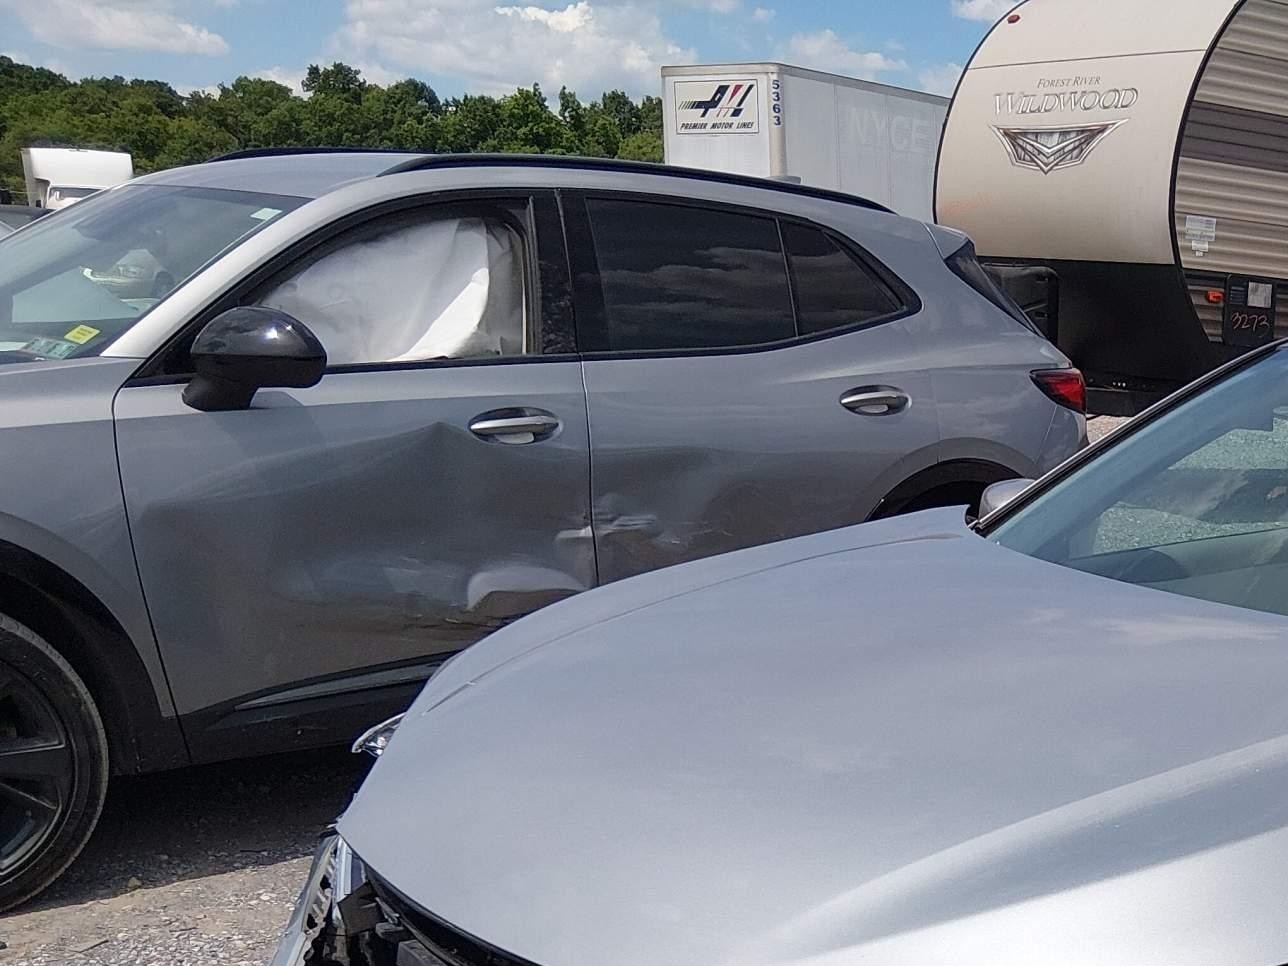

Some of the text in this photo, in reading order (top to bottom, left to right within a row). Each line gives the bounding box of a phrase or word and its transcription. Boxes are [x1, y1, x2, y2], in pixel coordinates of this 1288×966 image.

[1037, 75, 1101, 89] FOREST RIVER
[771, 79, 781, 126] 5363
[993, 87, 1139, 115] WILDWOOD
[680, 121, 755, 131] PREMIER MOTOR LINES
